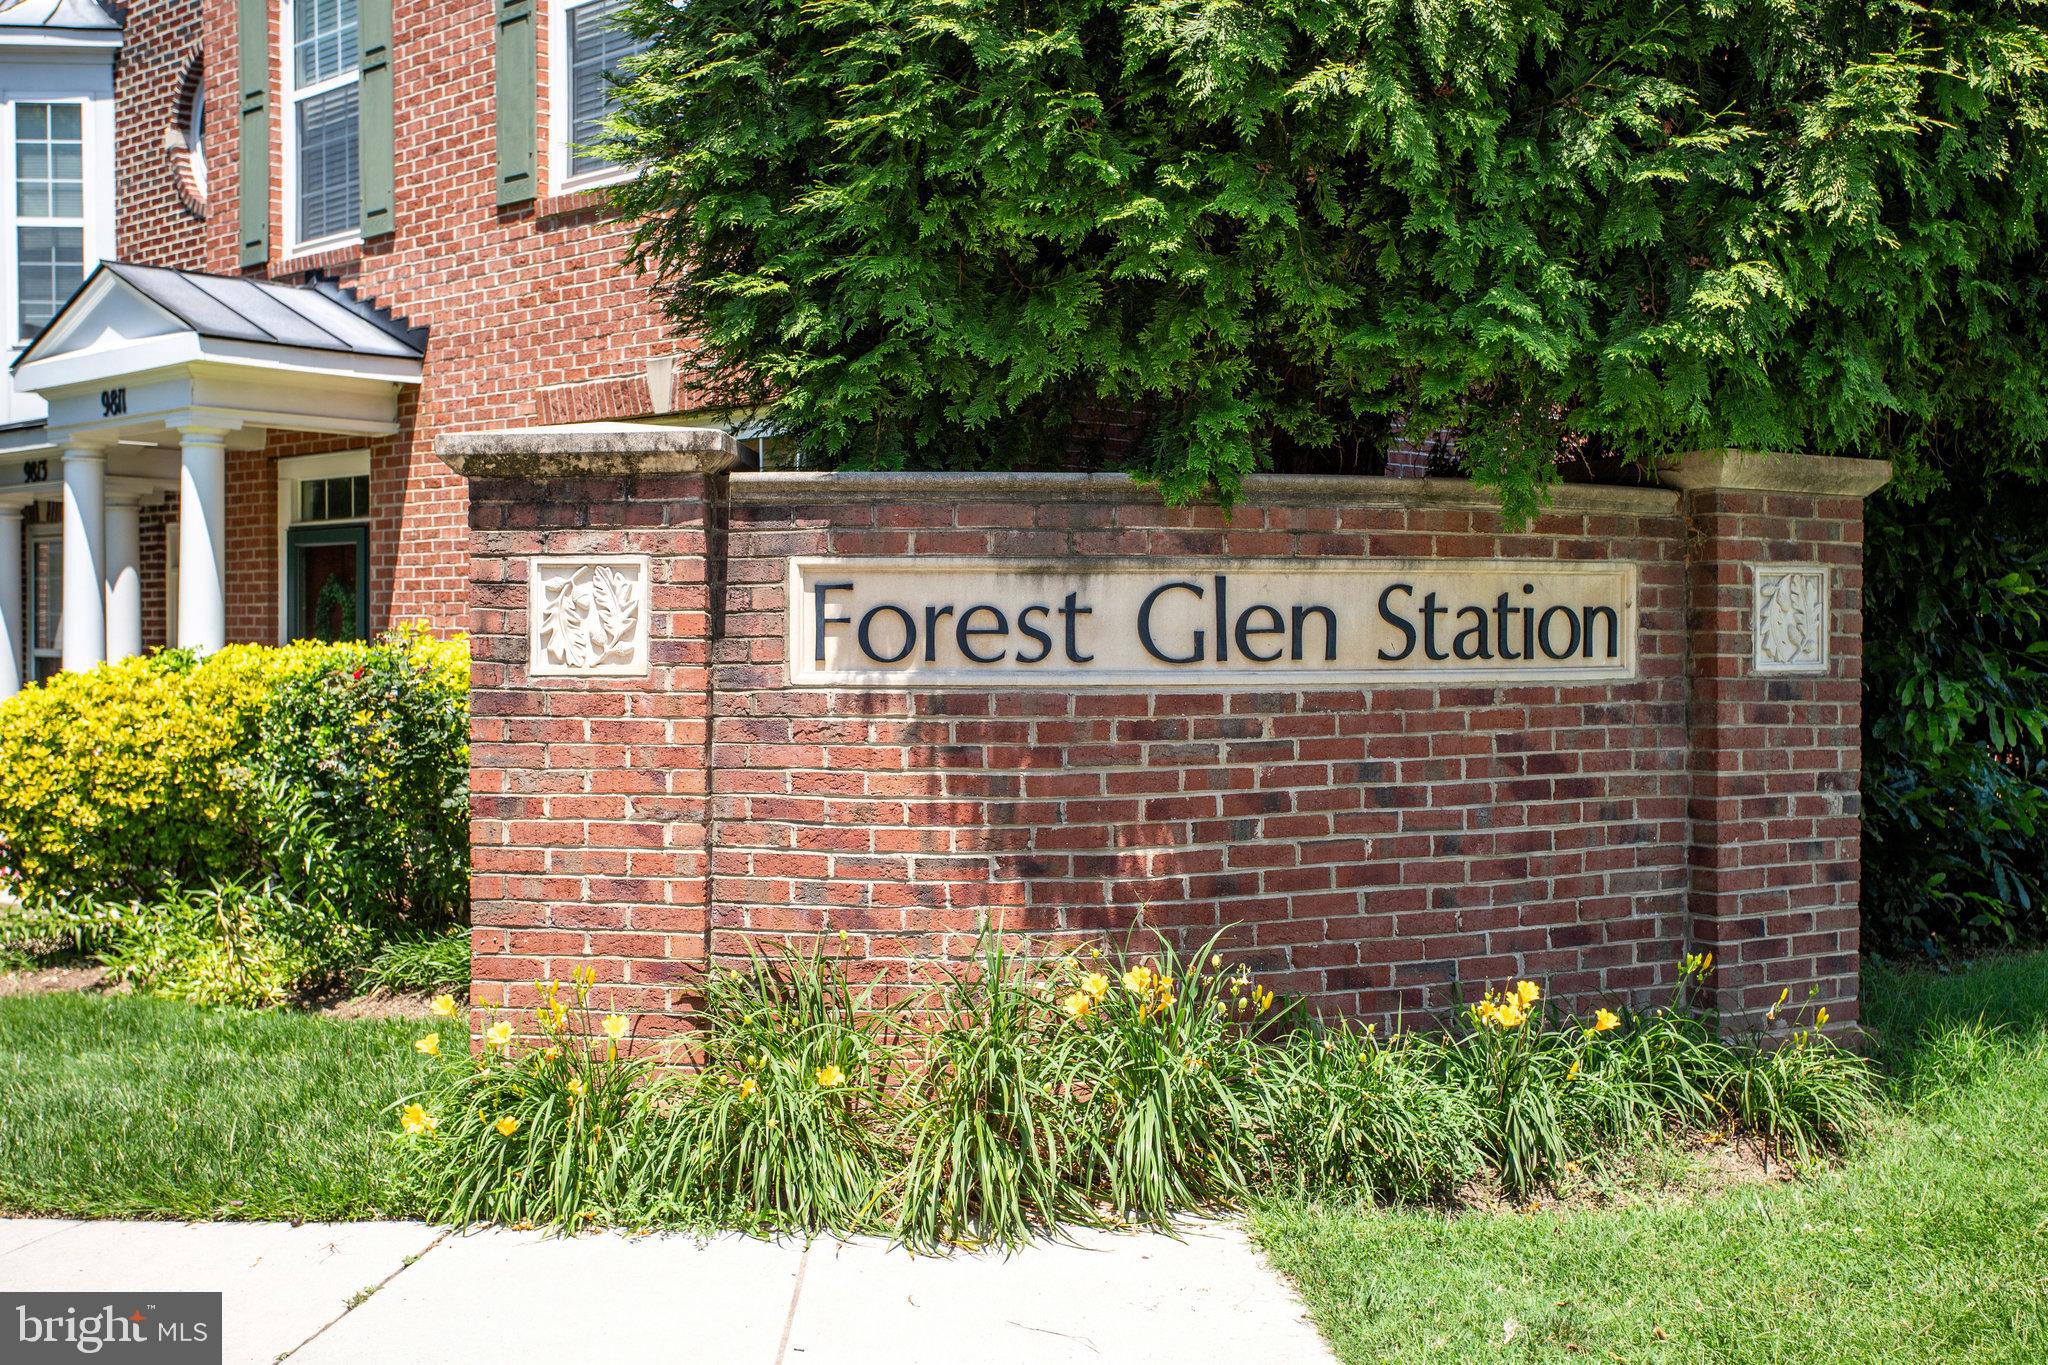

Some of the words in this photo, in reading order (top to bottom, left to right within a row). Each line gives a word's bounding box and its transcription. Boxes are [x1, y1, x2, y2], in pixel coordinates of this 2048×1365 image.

[814, 583, 1094, 664] Forest
[1137, 576, 1337, 665] Glen
[1377, 583, 1618, 662] Station
